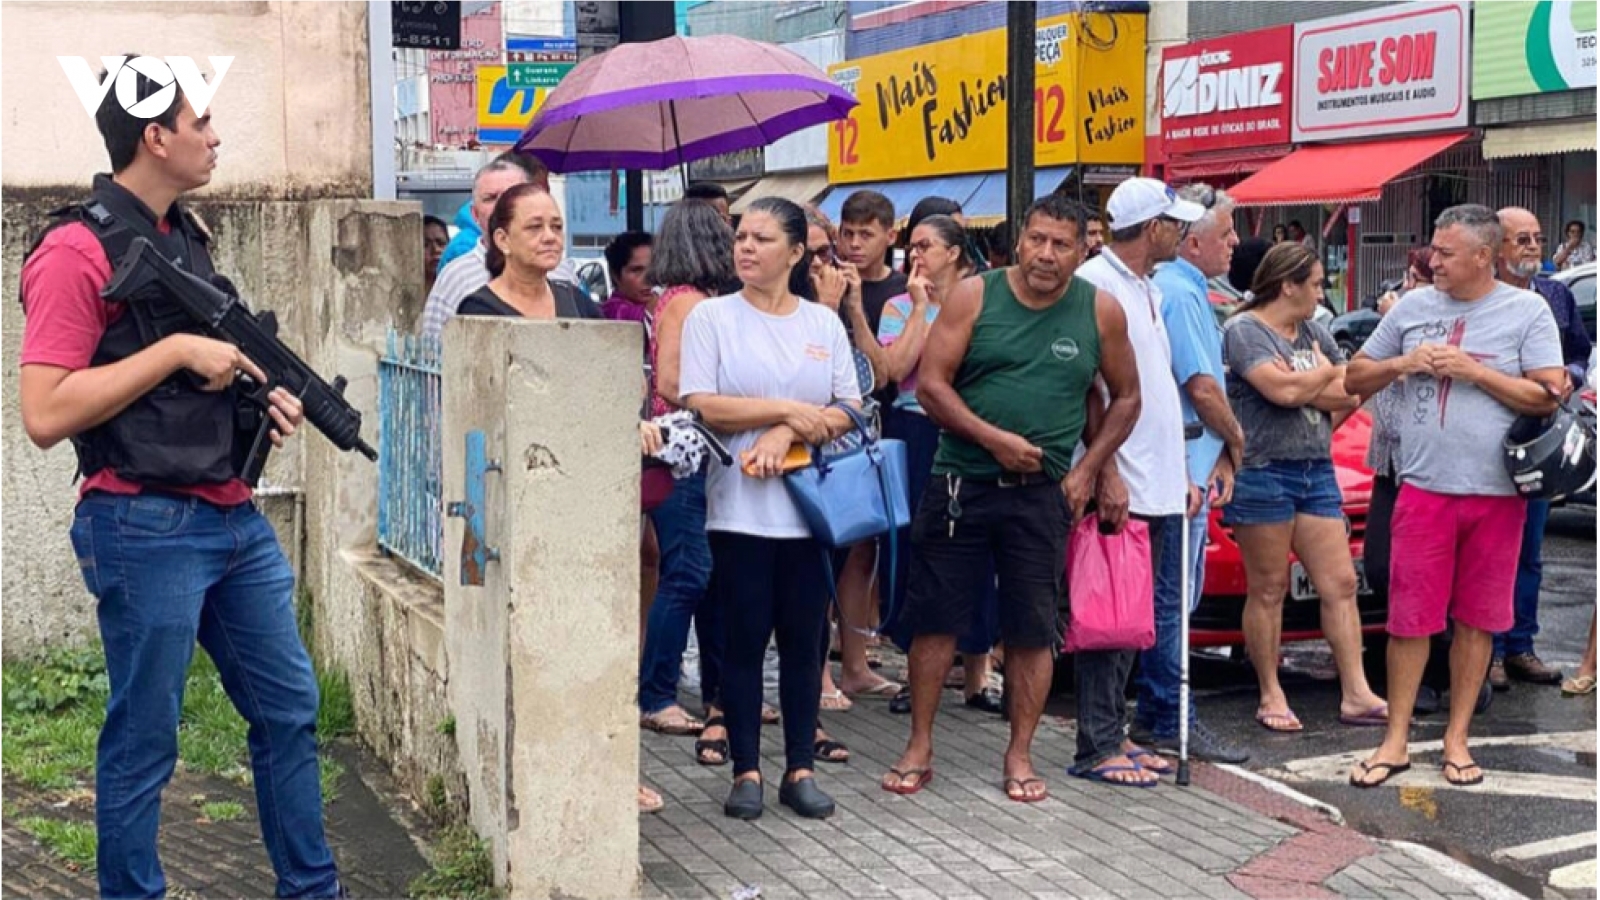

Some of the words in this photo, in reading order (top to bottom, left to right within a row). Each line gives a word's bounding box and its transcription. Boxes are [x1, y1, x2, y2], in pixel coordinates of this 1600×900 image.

[1317, 41, 1376, 94] SAVE
[1378, 30, 1437, 85] SOM
[876, 62, 937, 130] Mais
[1088, 86, 1130, 114] Mais
[1199, 62, 1283, 114] DINIZ
[1317, 95, 1368, 110] INSTRUMENTOS
[1370, 90, 1403, 105] MUSICAIS
[1405, 90, 1410, 101] E
[1035, 84, 1066, 143] 12
[1084, 115, 1136, 145] Fashion
[1165, 131, 1170, 140] A
[1171, 128, 1191, 139] MAIOR
[1192, 126, 1209, 137] REDE
[1211, 125, 1219, 135] DE
[1246, 121, 1255, 131] DO
[1257, 118, 1280, 130] BRASIL
[835, 118, 859, 165] 12
